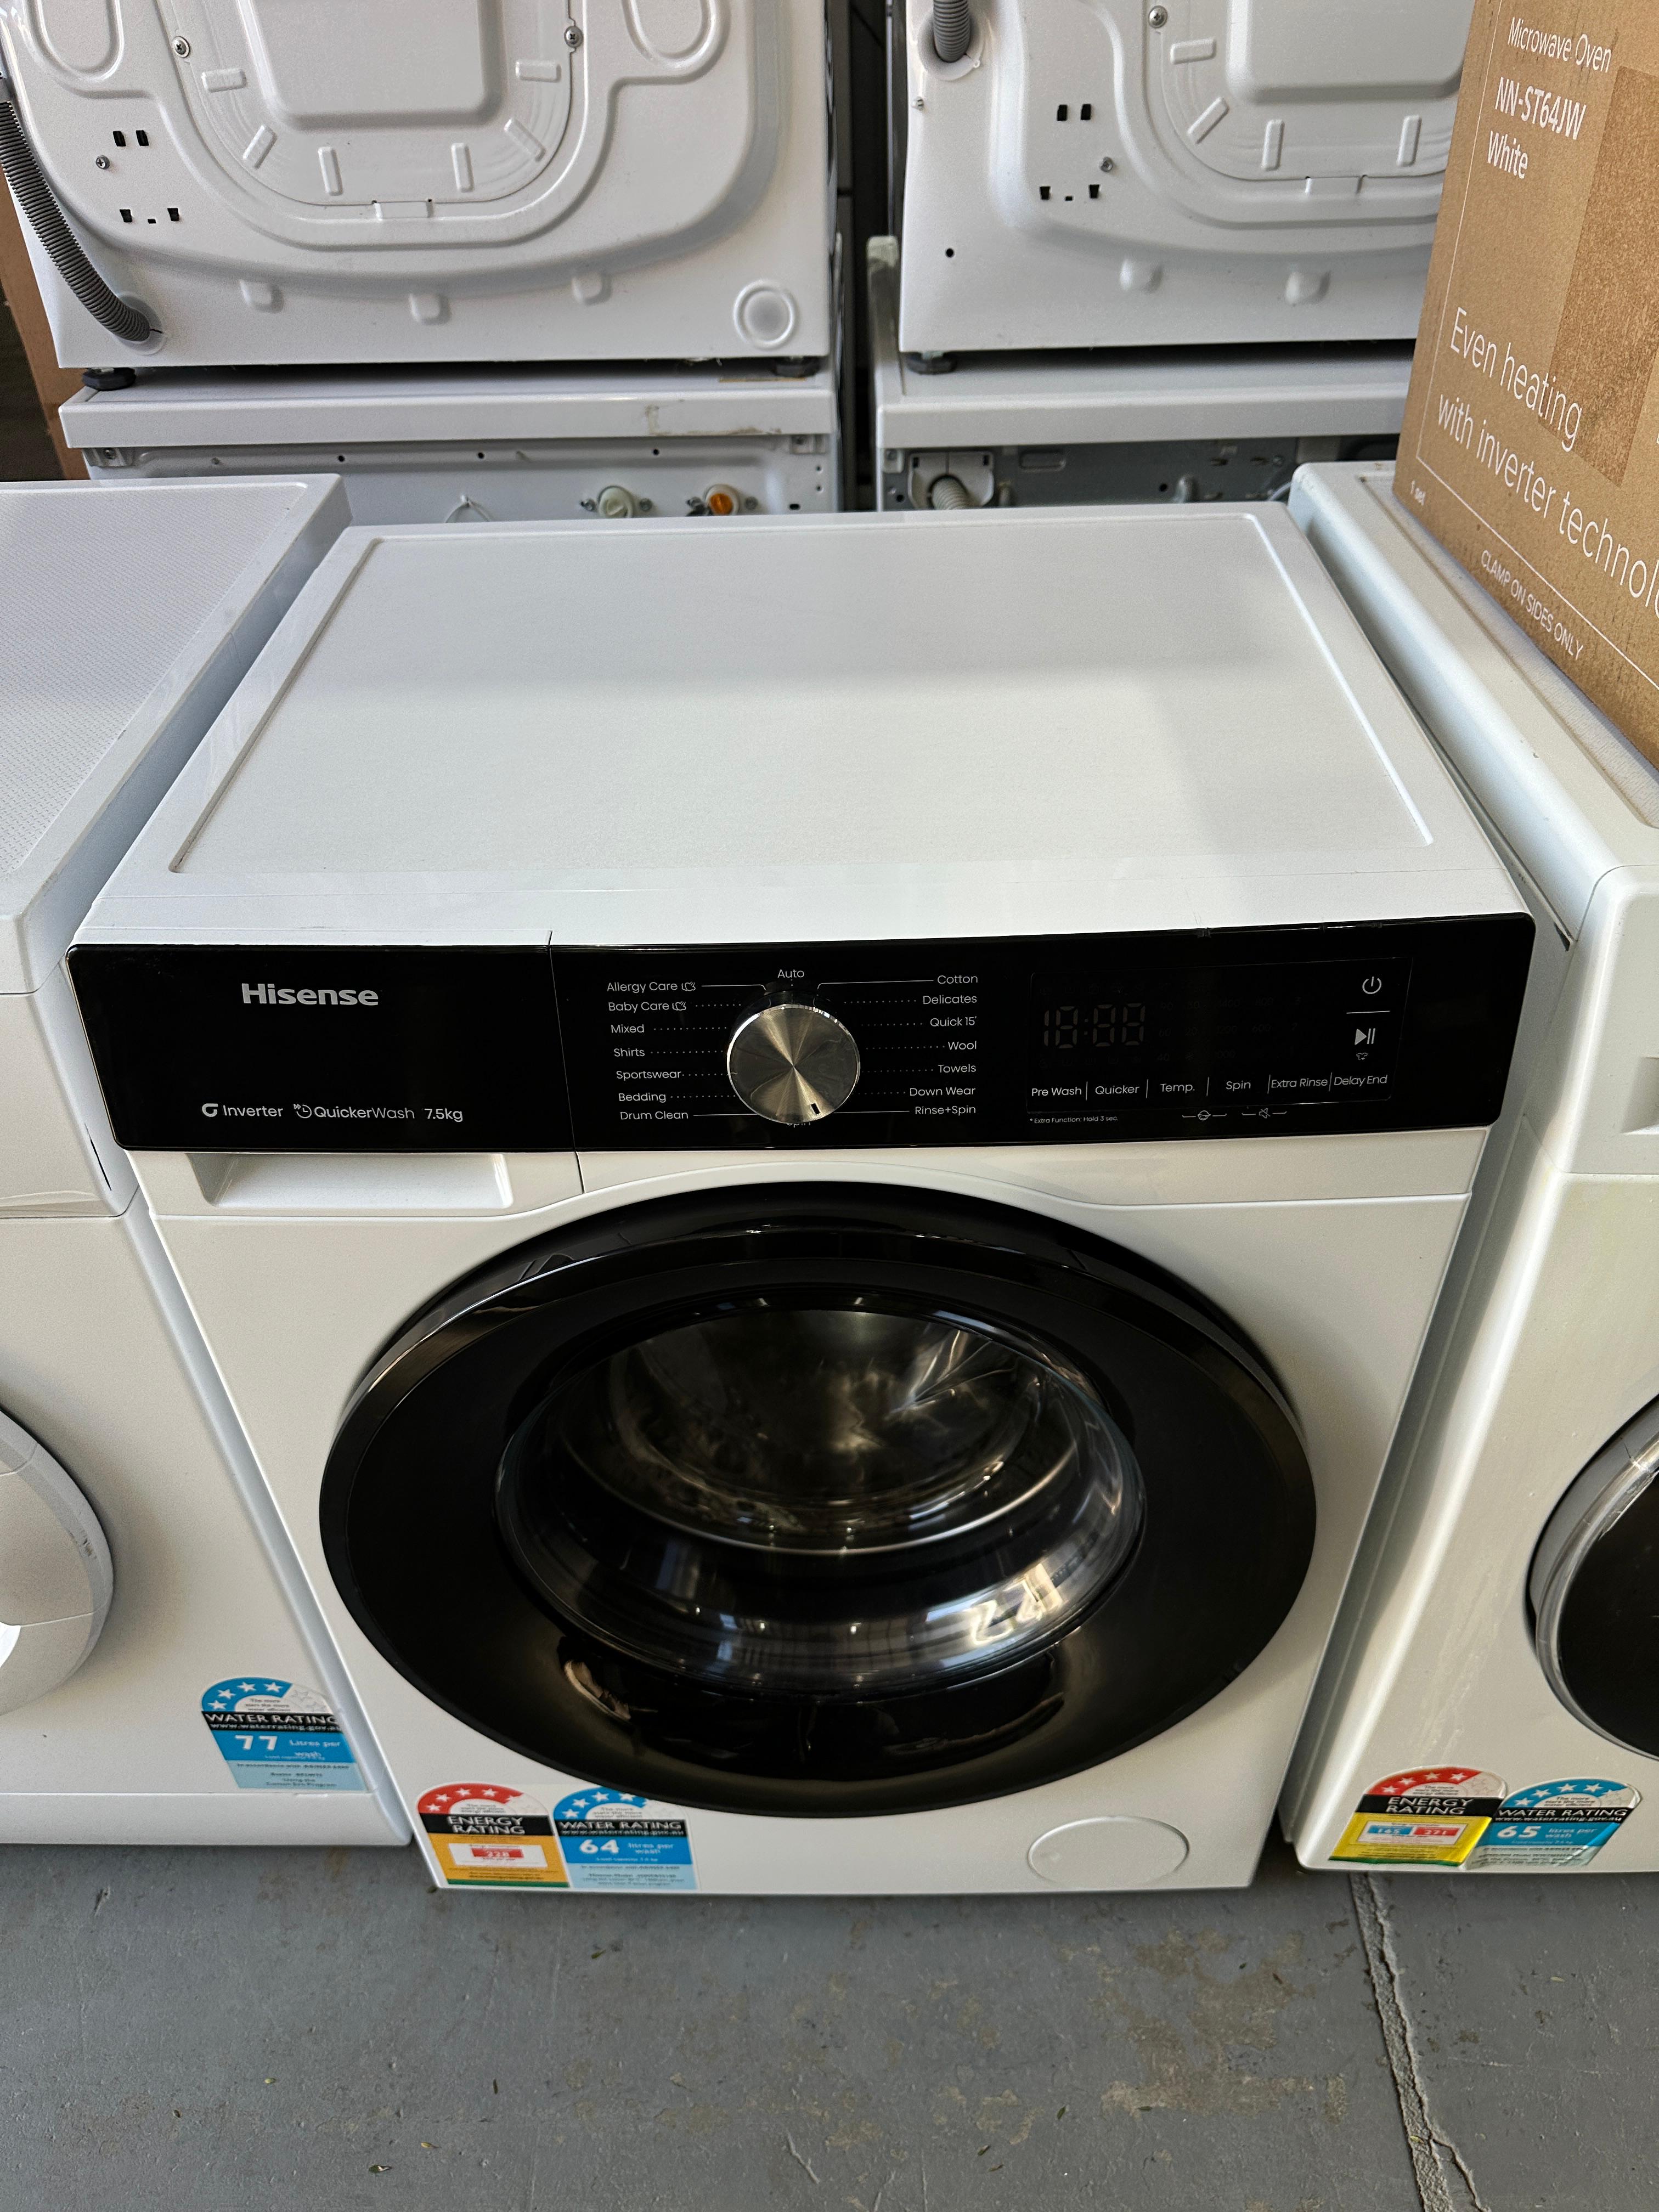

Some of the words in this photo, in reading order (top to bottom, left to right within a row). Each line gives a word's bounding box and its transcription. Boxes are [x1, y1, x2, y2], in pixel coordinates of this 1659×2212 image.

[1508, 16, 1572, 62] Microwave
[1576, 34, 1611, 72] Oven
[1495, 77, 1587, 140] NN-ST64JW
[1487, 131, 1528, 179] White
[1449, 307, 1497, 378] Even
[1500, 342, 1582, 452] heating
[1438, 394, 1474, 449] with
[1476, 419, 1556, 518] inverter
[1559, 491, 1659, 619] technol
[1481, 550, 1510, 589] CLAMP
[1510, 581, 1527, 610] ON
[1526, 592, 1554, 634] SIDES
[1554, 622, 1584, 661] ONLY
[777, 969, 805, 978] Auto
[937, 975, 978, 984] Cotton
[607, 982, 646, 994] Allergy
[649, 981, 678, 991] Care
[241, 983, 379, 1006] Hisense
[923, 995, 978, 1005] Delicates
[608, 1002, 639, 1013] Baby
[641, 1001, 669, 1011] Care
[930, 1017, 963, 1027] Quick
[611, 1024, 645, 1034] Mixed
[947, 1040, 977, 1051] Wool
[613, 1047, 645, 1057] Shirts
[938, 1063, 977, 1073] Towels
[616, 1070, 681, 1081] Sportswear
[1334, 1076, 1365, 1087] Delay
[1367, 1074, 1388, 1084] End
[1226, 1080, 1251, 1092] Spin
[1271, 1079, 1297, 1088] Extra
[1299, 1077, 1328, 1087] Rinse
[910, 1087, 943, 1097] Down
[945, 1086, 976, 1096] Wear
[1031, 1088, 1049, 1097] Pre
[1051, 1086, 1082, 1096] Wash
[1095, 1085, 1140, 1094] Quicker
[1160, 1083, 1195, 1094] Temp.
[618, 1092, 667, 1103] Bedding
[223, 1105, 284, 1117] Inverter
[314, 1105, 415, 1119] QuickerWash
[424, 1108, 463, 1122] 7.5kg
[620, 1111, 652, 1120] Drum
[654, 1110, 689, 1120] Clean
[915, 1105, 976, 1116] Rinse+Spin
[205, 1713, 269, 1723] WATER
[234, 1735, 278, 1751] 77
[1388, 1797, 1474, 1807] ENERGY
[1386, 1805, 1466, 1815] RATING
[1561, 1809, 1628, 1817] RATING
[447, 1816, 523, 1826] ENERGY
[559, 1821, 615, 1830] WATER
[619, 1821, 682, 1830] RATING
[452, 1825, 526, 1835] RATING
[1497, 1825, 1542, 1838] 65
[579, 1839, 619, 1854] 64
